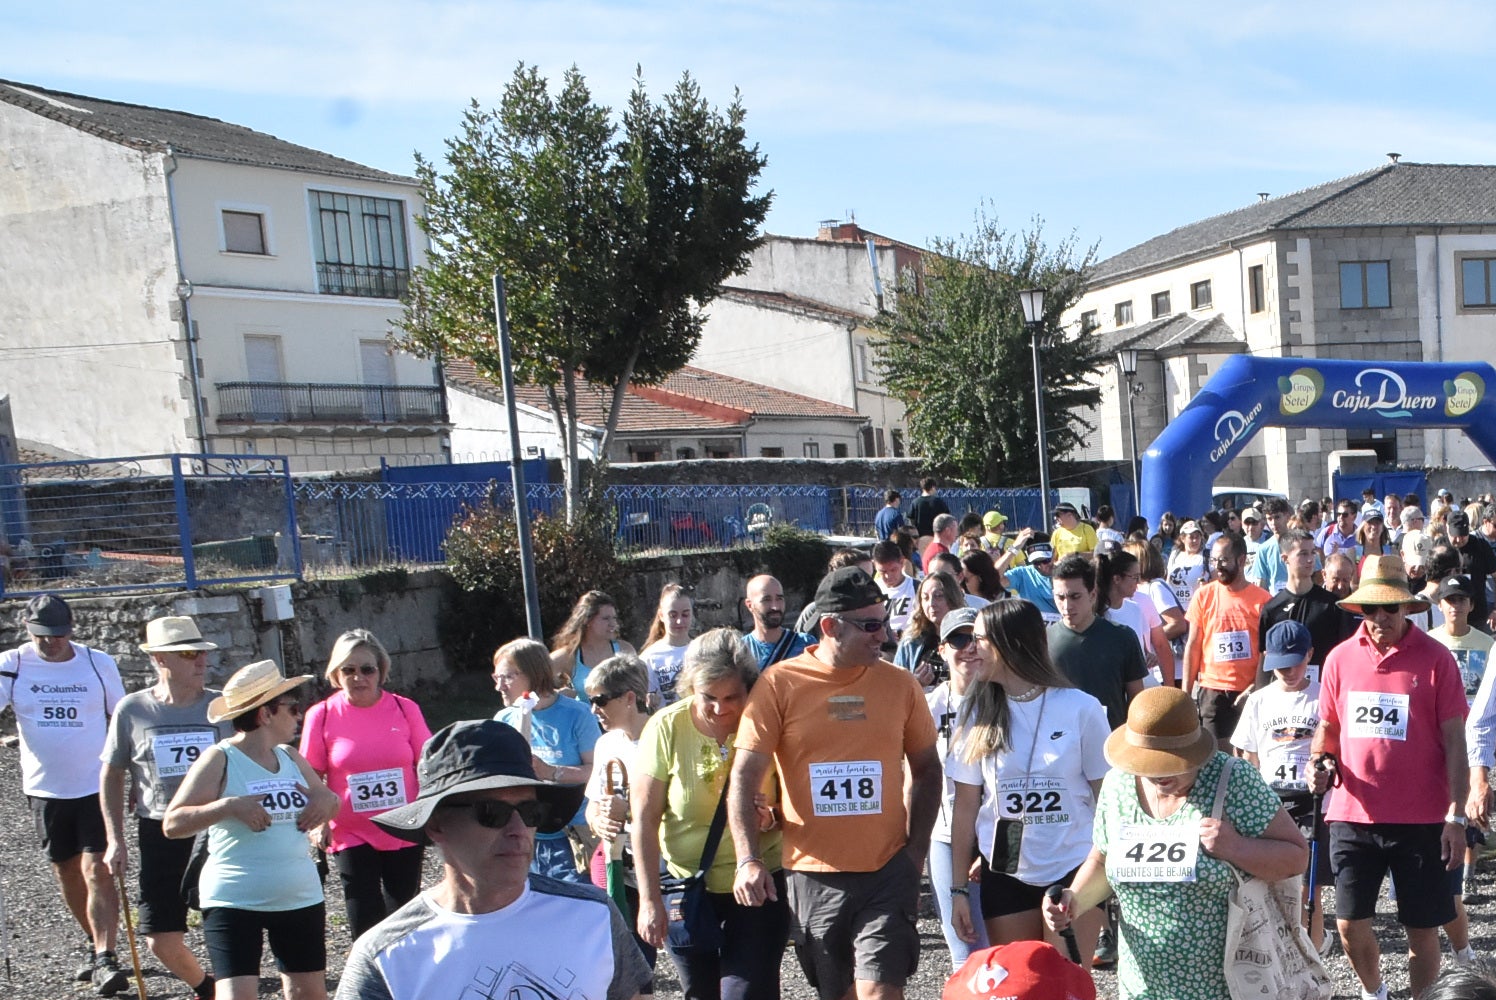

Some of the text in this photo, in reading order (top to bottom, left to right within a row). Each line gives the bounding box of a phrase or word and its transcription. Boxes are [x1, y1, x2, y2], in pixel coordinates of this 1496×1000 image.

[1292, 383, 1315, 393] Grupo
[1332, 368, 1436, 413] Caja Duero
[1456, 387, 1476, 396] Grupo
[1284, 395, 1308, 407] Setel
[1449, 397, 1471, 408] Setel
[1210, 403, 1262, 462] Caja Duero
[1176, 590, 1190, 598] 485
[1219, 641, 1244, 654] 513
[40, 684, 88, 693] Columbia
[43, 706, 78, 720] 580
[1355, 706, 1400, 726] 294
[1263, 715, 1319, 731] SHARK BEACH
[357, 780, 399, 801] 343
[820, 777, 874, 801] 418
[262, 791, 306, 811] 408
[1006, 791, 1062, 814] 322
[815, 803, 848, 814] FUENTES
[848, 802, 858, 812] DE
[1034, 815, 1044, 825] DE
[1124, 842, 1187, 863] 426
[1116, 866, 1152, 878] FUENTES
[1154, 866, 1164, 877] DE
